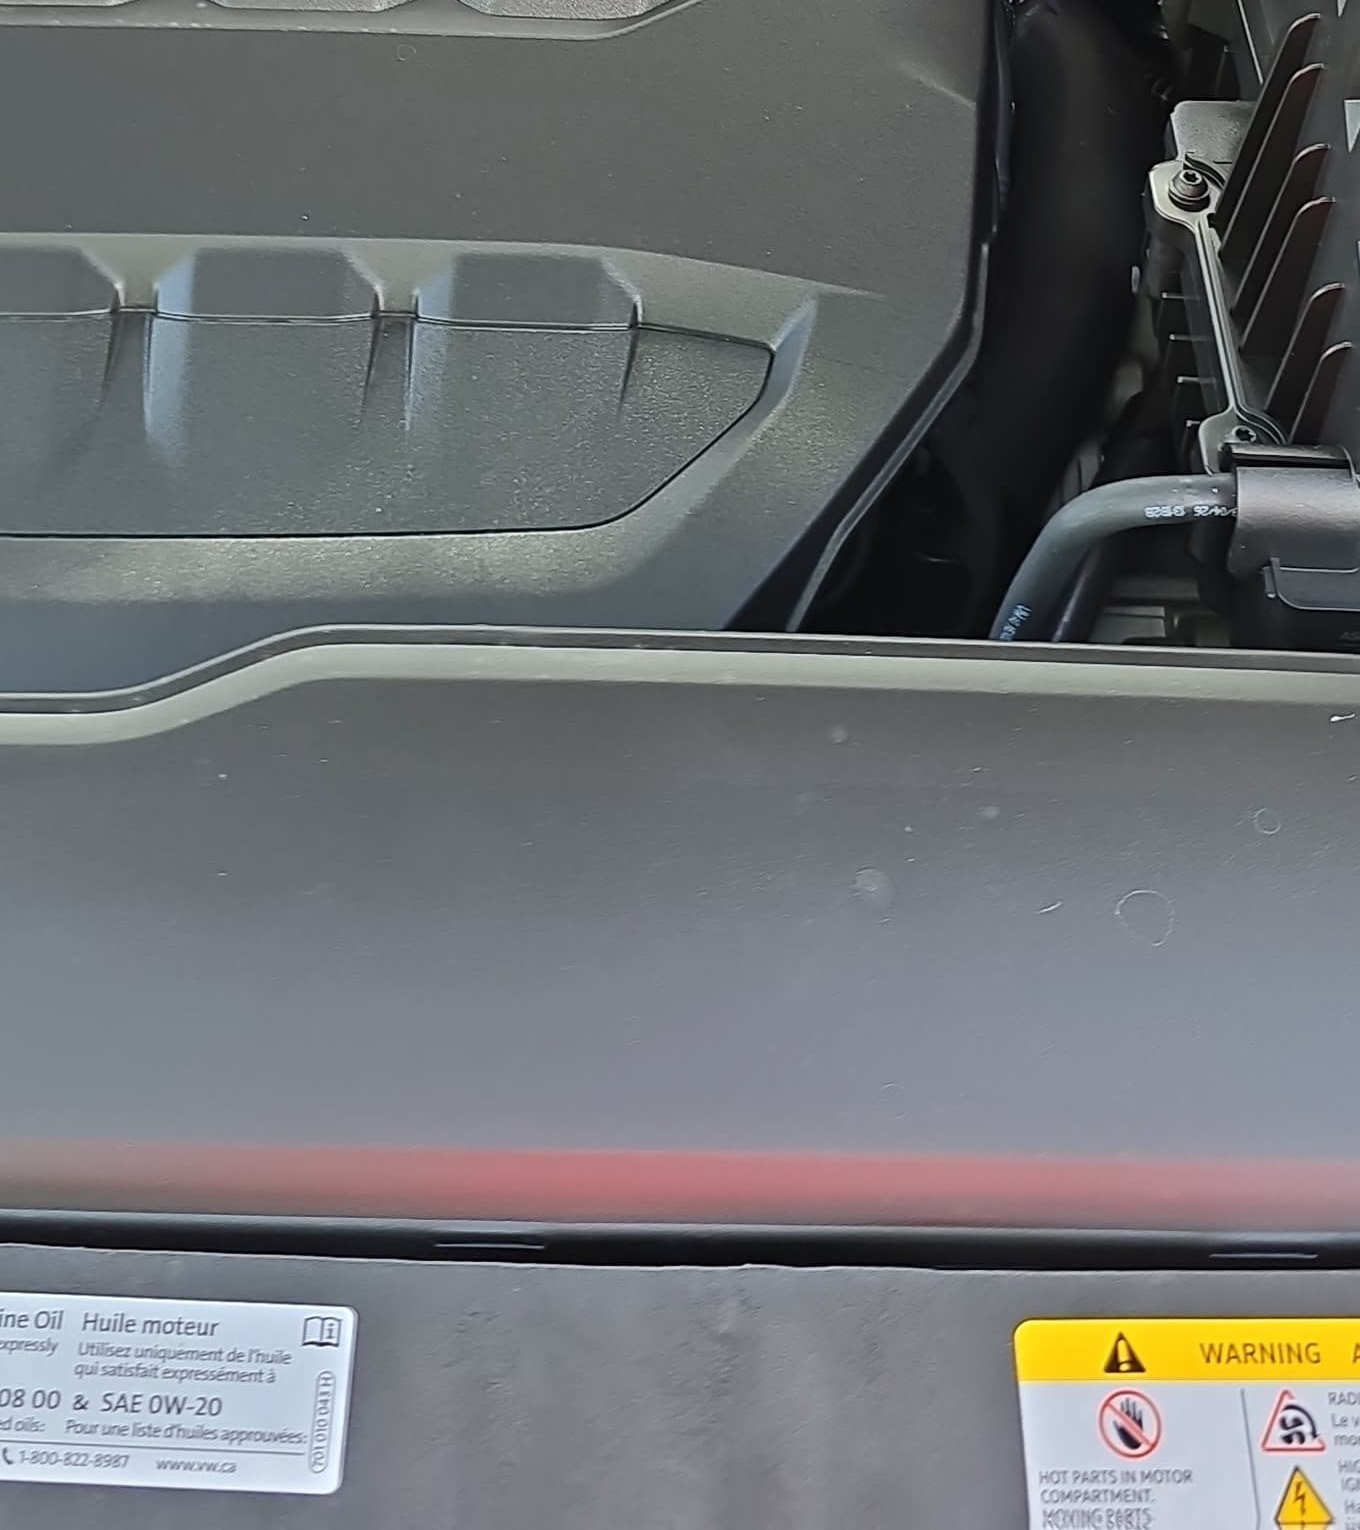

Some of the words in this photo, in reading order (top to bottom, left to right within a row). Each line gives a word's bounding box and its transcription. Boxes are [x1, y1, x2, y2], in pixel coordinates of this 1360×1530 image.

[34, 1310, 65, 1331] Oil
[81, 1312, 137, 1334] Huile
[142, 1316, 220, 1337] moteur
[78, 1341, 138, 1358] Utilisez
[134, 1344, 225, 1364] uniquement
[227, 1346, 246, 1363] de
[246, 1348, 293, 1366] l'huile
[1200, 1342, 1322, 1365] WARNING
[74, 1362, 99, 1380] qui
[100, 1363, 161, 1381] satisfait
[162, 1365, 260, 1384] expressément
[31, 1389, 62, 1410] 00
[72, 1393, 90, 1412] &
[99, 1392, 144, 1415] SAE
[148, 1394, 224, 1417] 0W-20
[14, 1418, 47, 1434] oils:
[1332, 1412, 1349, 1428] Le
[65, 1419, 100, 1435] Pour
[101, 1422, 129, 1437] une
[131, 1421, 161, 1438] liste
[163, 1422, 219, 1441] d'huiles
[219, 1426, 309, 1446] approuvées:
[1039, 1469, 1069, 1485] HOT
[1071, 1469, 1119, 1485] PARTS
[1120, 1469, 1137, 1485] IN
[1139, 1469, 1193, 1485] MOTOR
[1040, 1488, 1158, 1504] COMPARTMENT.
